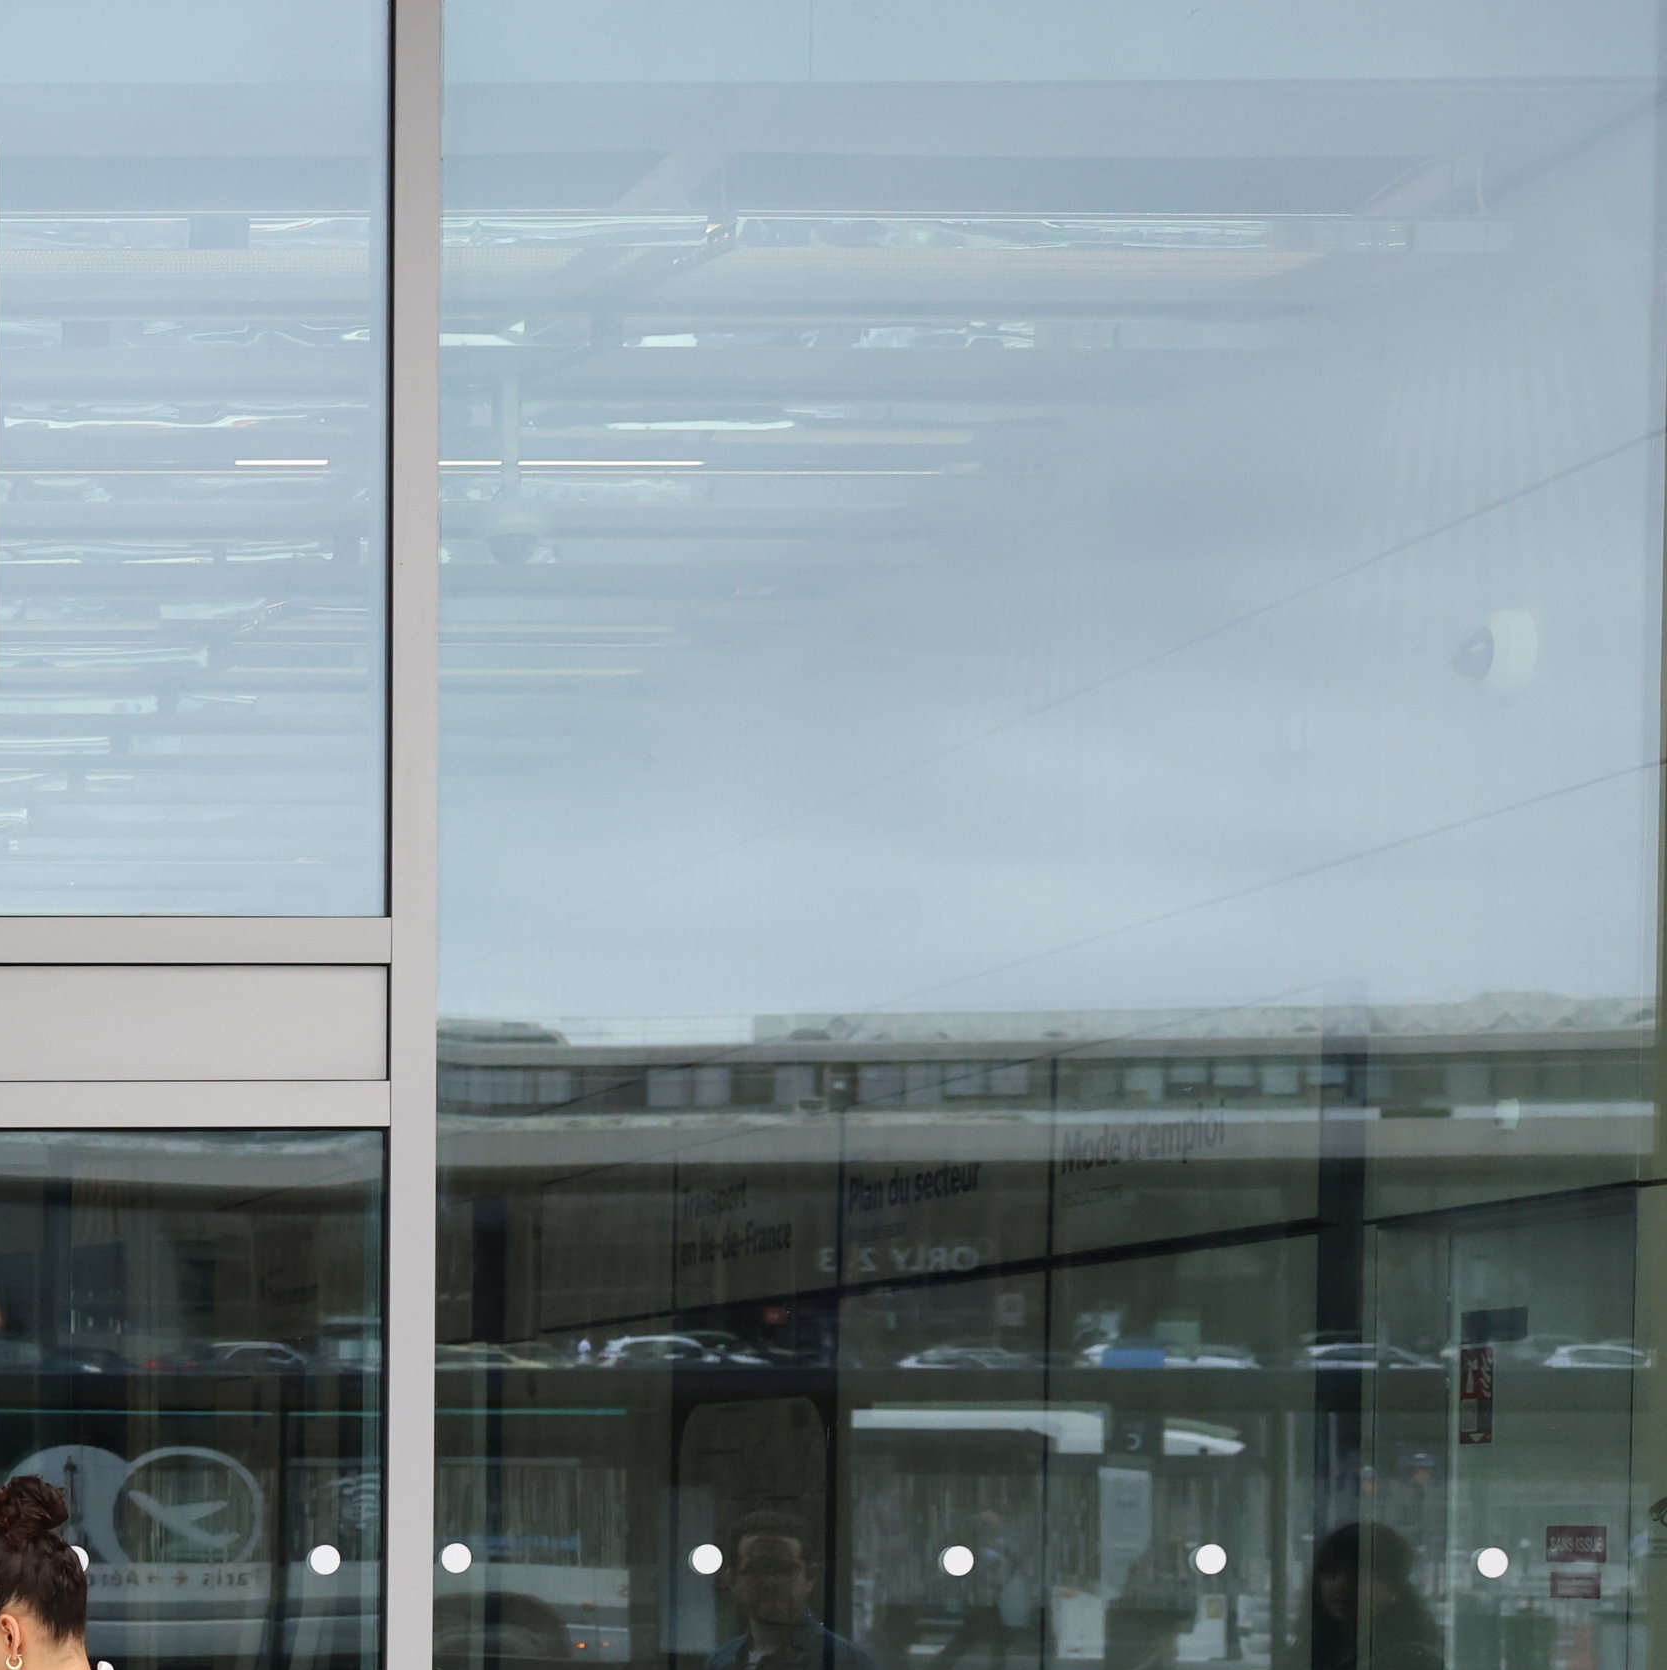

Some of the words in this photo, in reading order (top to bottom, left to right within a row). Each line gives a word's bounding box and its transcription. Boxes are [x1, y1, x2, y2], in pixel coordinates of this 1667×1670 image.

[849, 1174, 883, 1213] Plan
[888, 1167, 910, 1206] du
[914, 1162, 981, 1202] secteur
